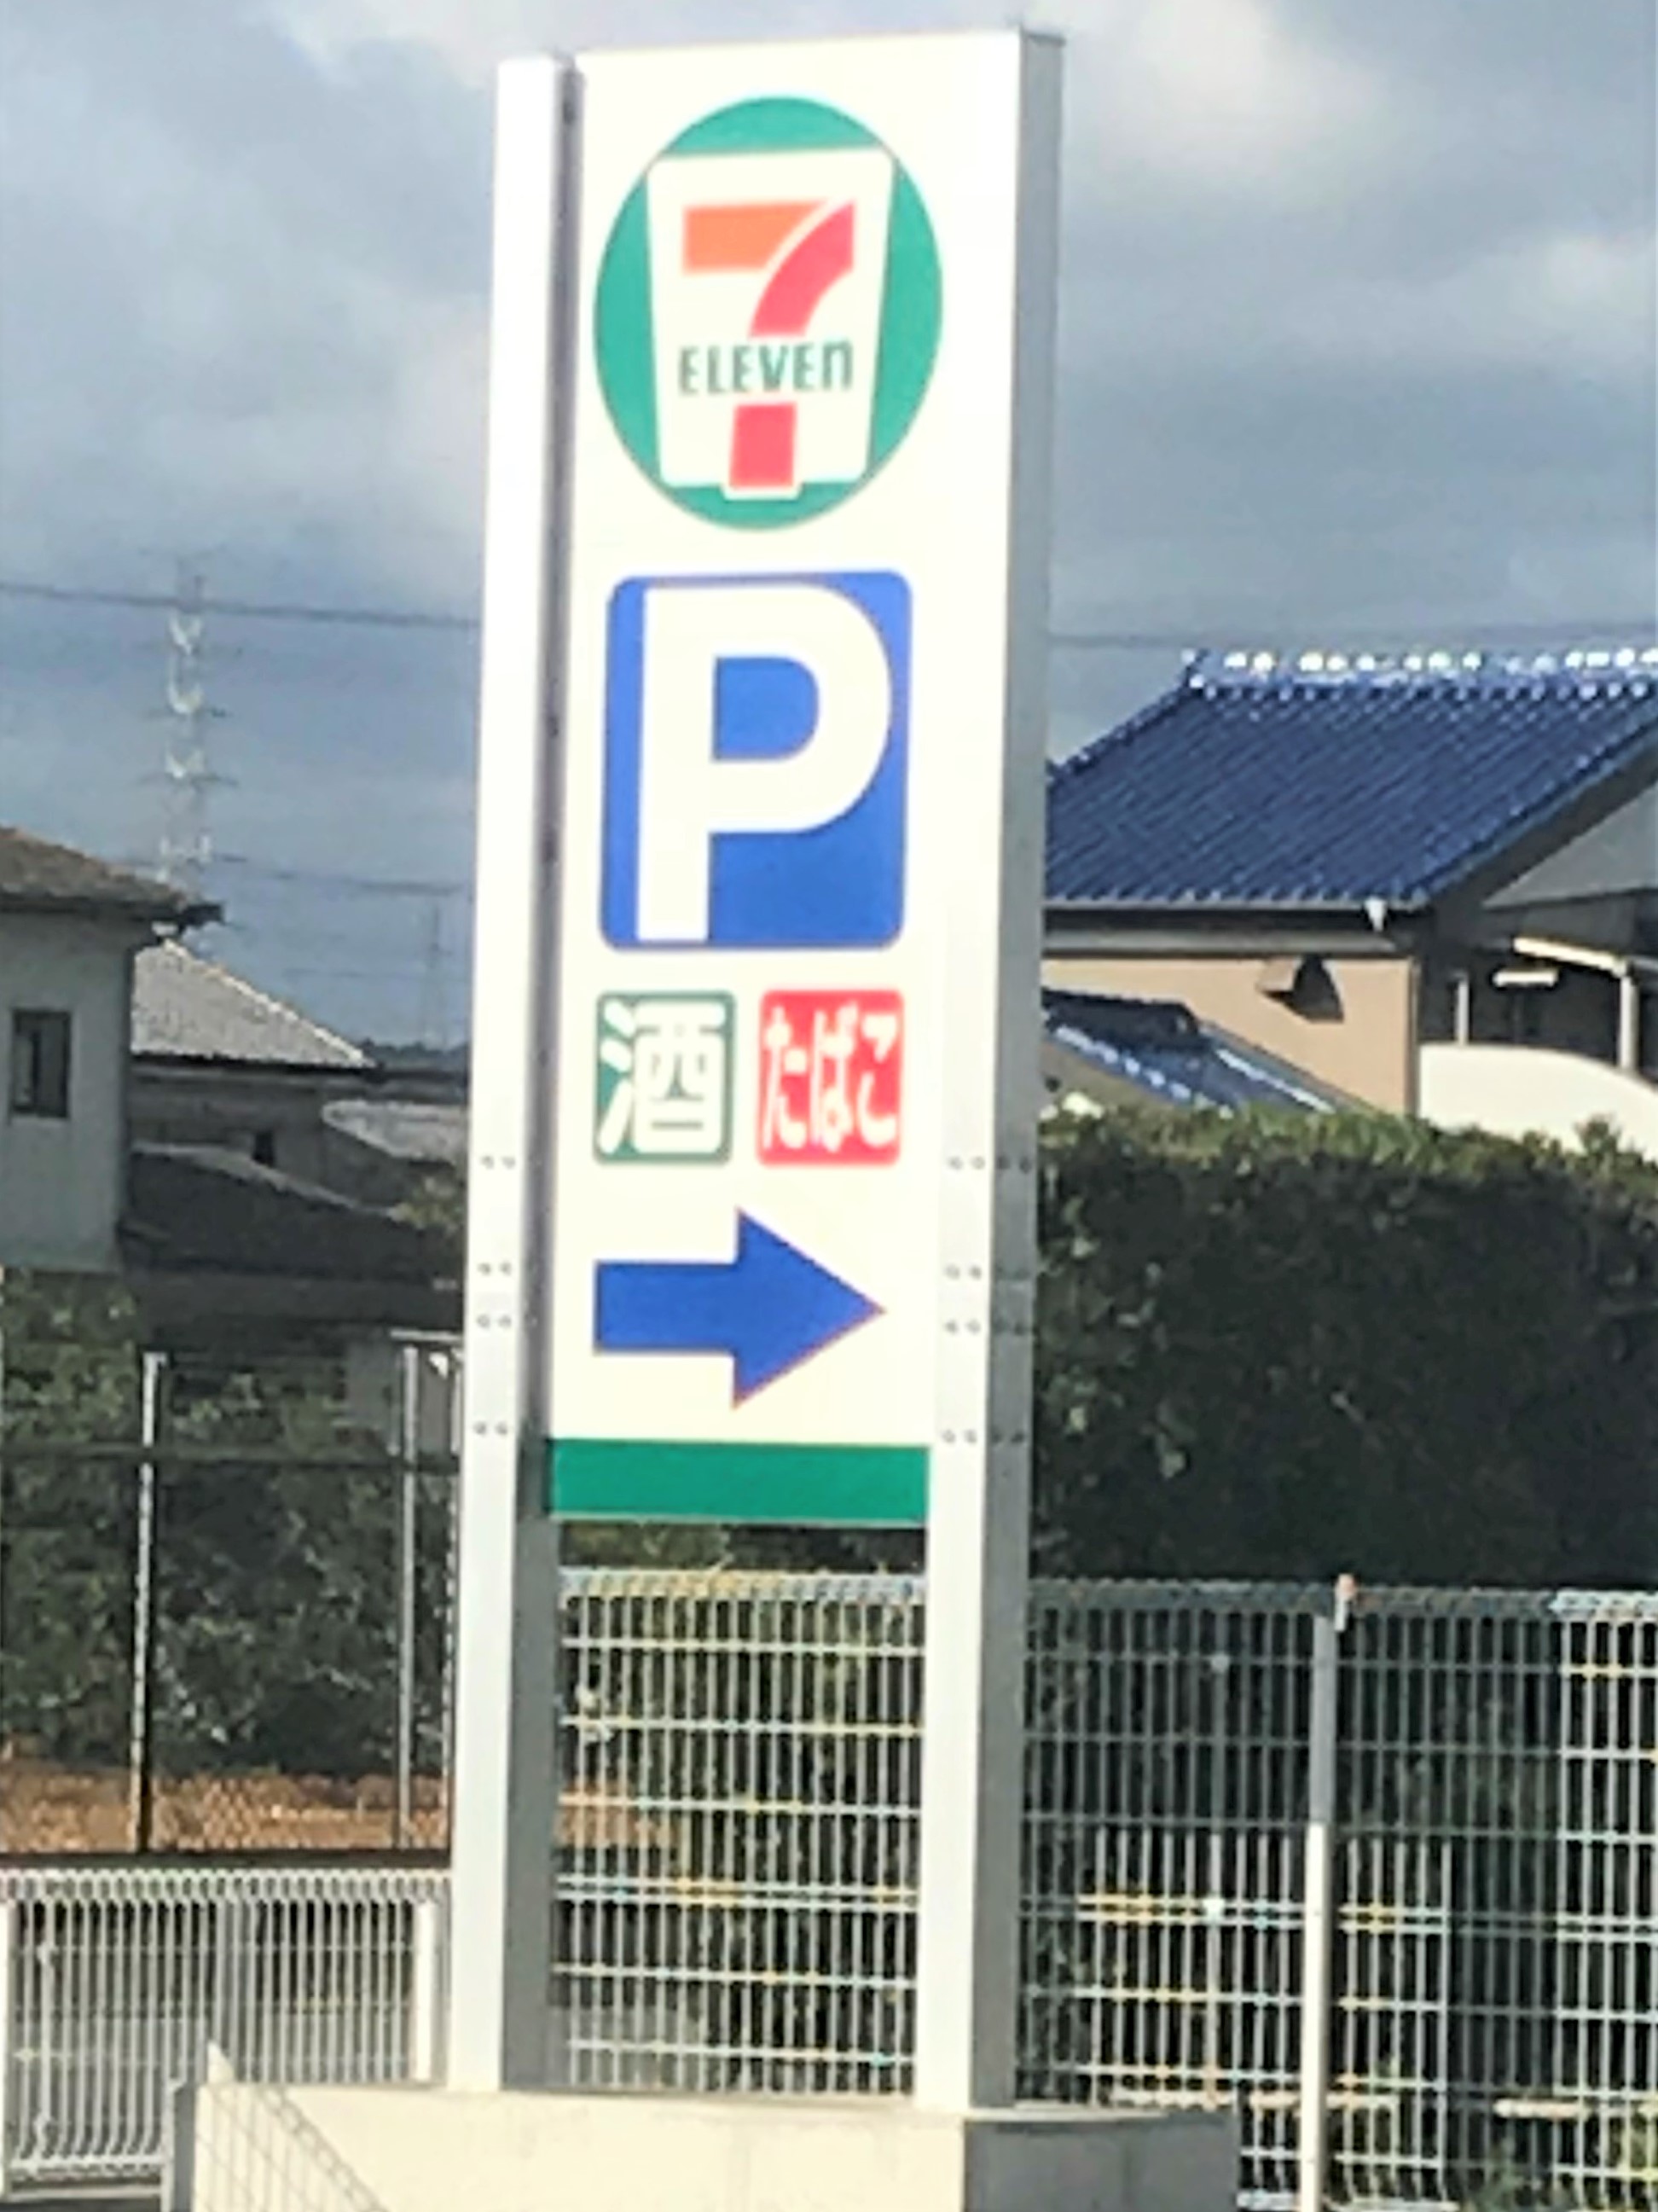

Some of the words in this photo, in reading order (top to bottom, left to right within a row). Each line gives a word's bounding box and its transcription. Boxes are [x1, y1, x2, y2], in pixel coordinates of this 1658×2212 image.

[683, 199, 855, 490] 7
[636, 587, 892, 942] P
[599, 998, 726, 1154] 酒
[764, 1001, 898, 1152] たばこ
